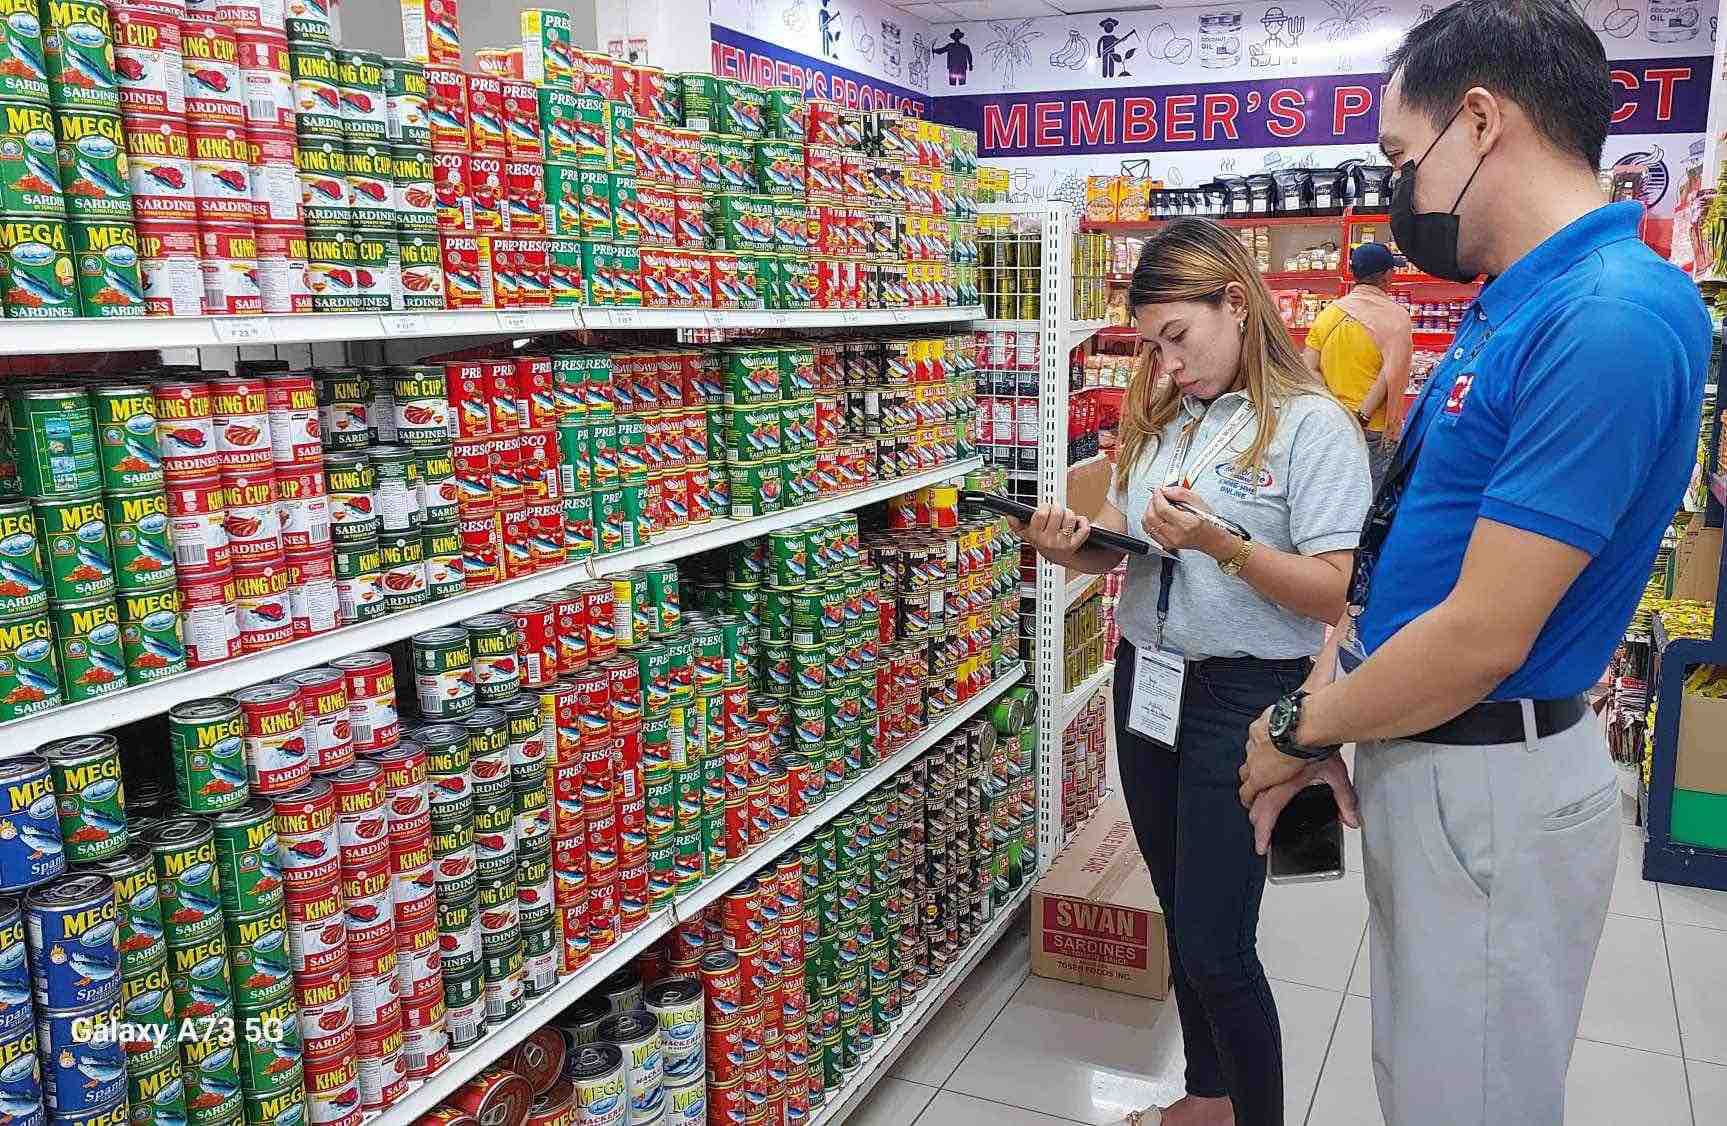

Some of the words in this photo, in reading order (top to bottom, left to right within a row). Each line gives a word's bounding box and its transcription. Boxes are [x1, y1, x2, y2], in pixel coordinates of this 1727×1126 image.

[50, 2, 112, 37] MEGA
[127, 25, 157, 46] CUP
[983, 88, 1306, 150] MEMBER'S
[1333, 85, 1386, 136] P
[60, 115, 124, 150] MEGA
[196, 138, 231, 158] KING
[360, 243, 384, 261] CUP
[11, 307, 74, 318] SARDINES
[72, 605, 117, 634] MEG
[1055, 900, 1134, 936] SWAN
[1054, 935, 1136, 960] SARDINES
